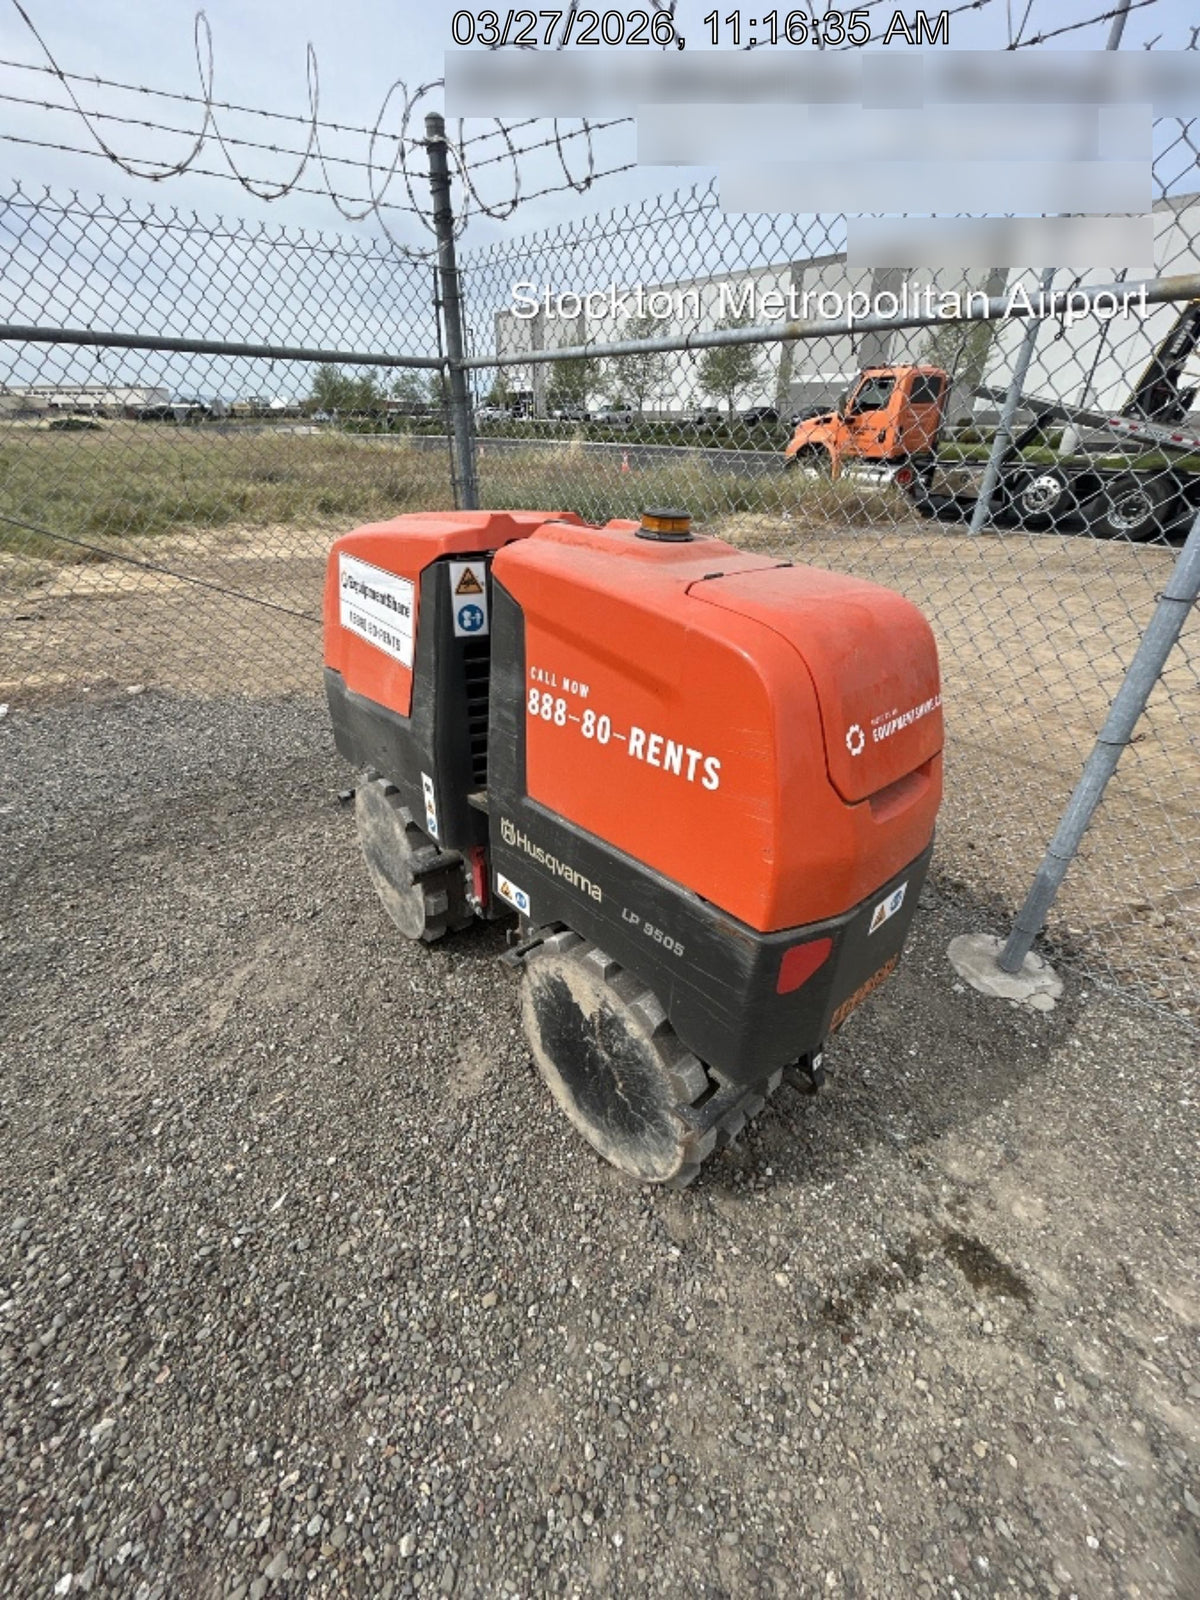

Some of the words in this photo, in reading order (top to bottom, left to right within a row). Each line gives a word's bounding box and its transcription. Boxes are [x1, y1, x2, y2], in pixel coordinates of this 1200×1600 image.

[530, 666, 557, 687] CALL
[562, 677, 589, 698] NOW
[527, 687, 721, 790] 888-80-RENTS
[516, 833, 602, 903] Husqvarna
[621, 907, 640, 925] LP
